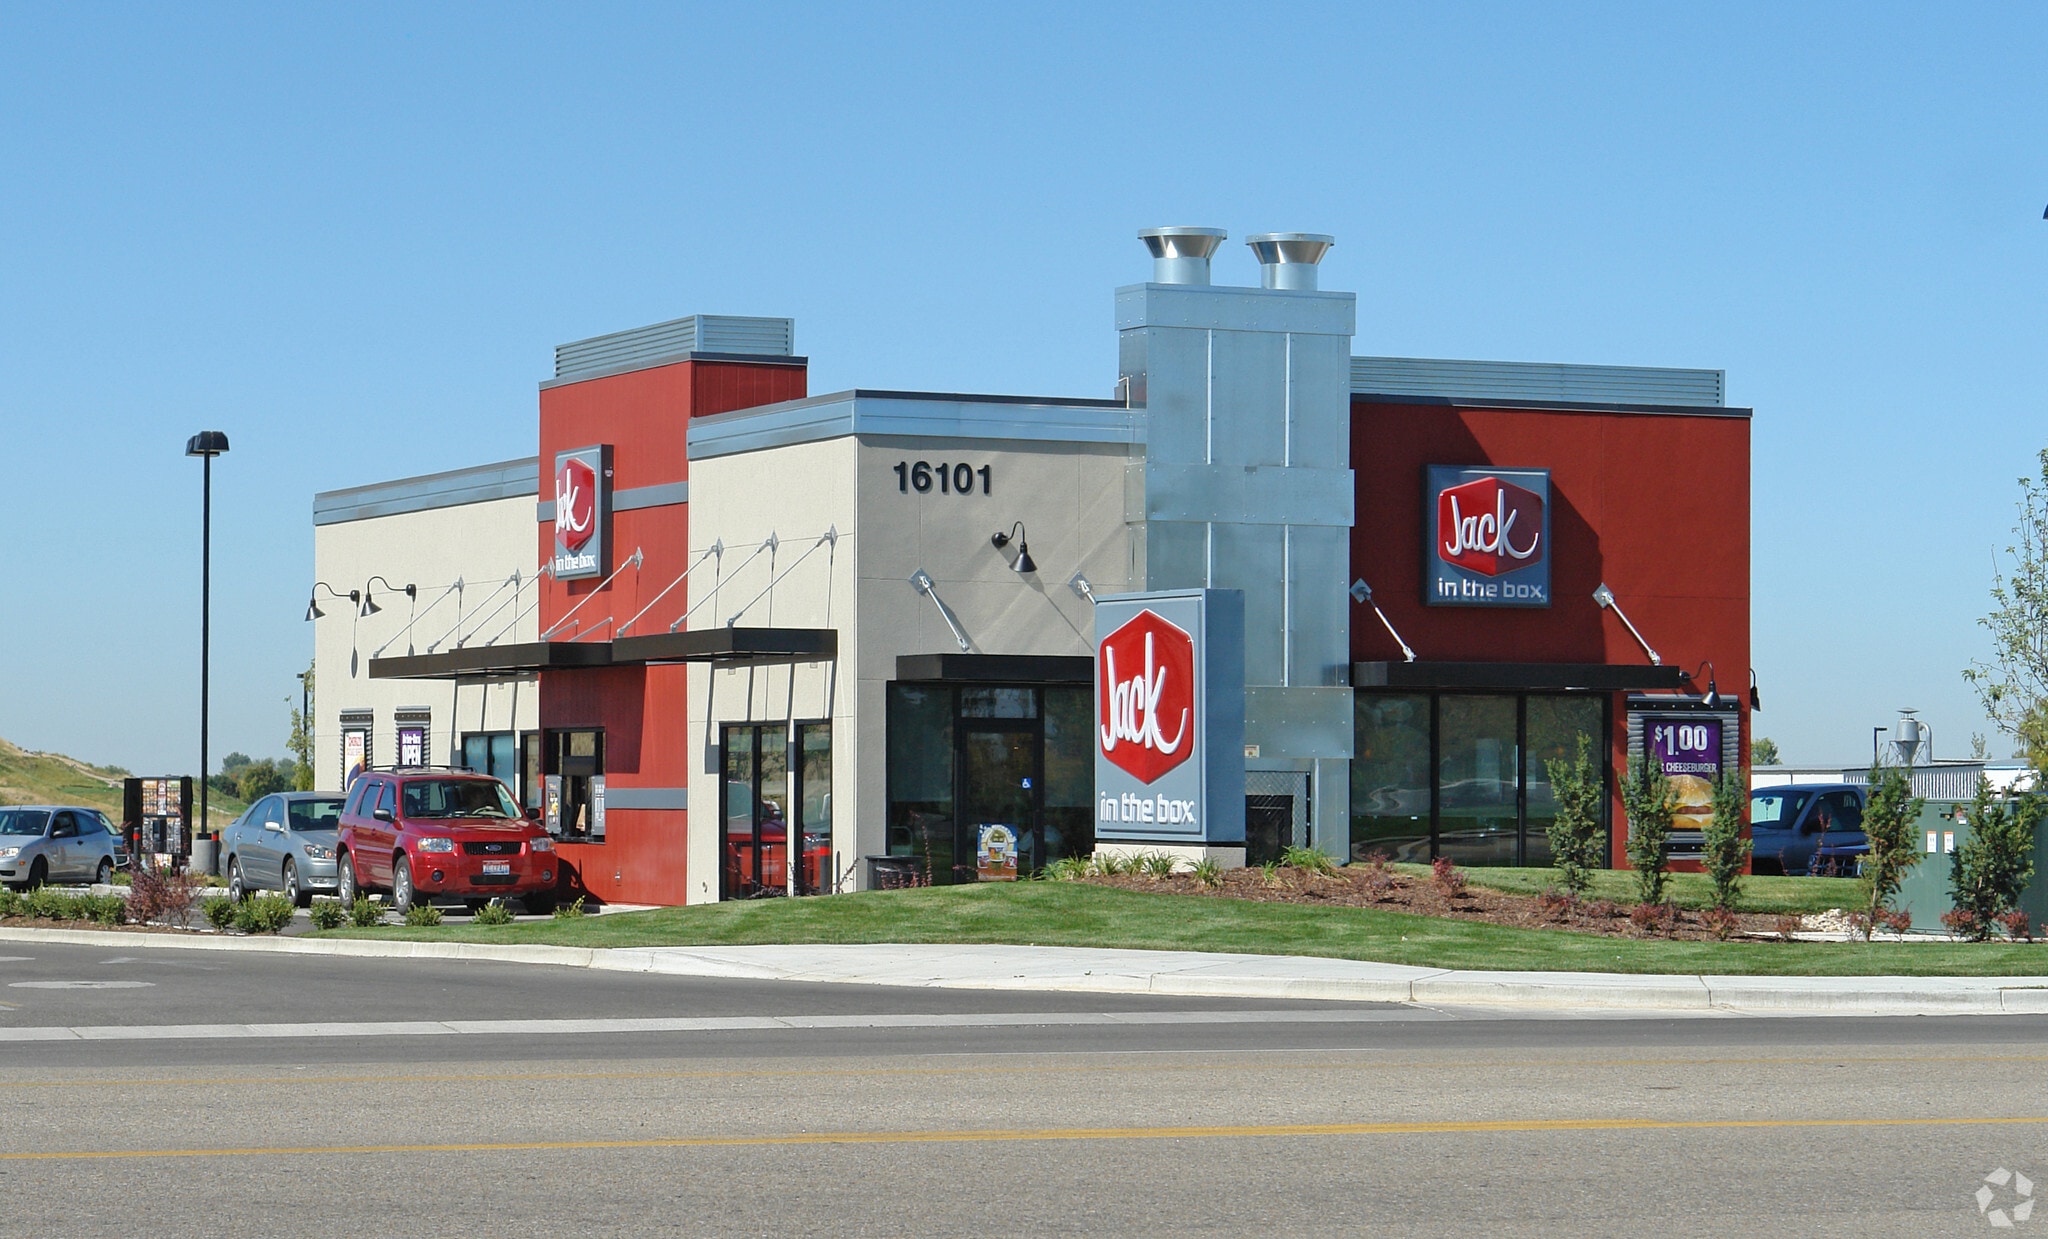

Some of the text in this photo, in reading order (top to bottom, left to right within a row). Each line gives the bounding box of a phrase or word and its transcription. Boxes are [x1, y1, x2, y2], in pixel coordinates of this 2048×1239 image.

[893, 461, 990, 494] 16101
[1445, 488, 1539, 560] Jack
[555, 555, 565, 572] in
[1438, 577, 1542, 598] in the box
[1101, 631, 1188, 755] Jack
[402, 744, 422, 766] OPEN
[1654, 725, 1708, 756] $1.00
[1665, 762, 1717, 773] CHEESEBURGER
[1100, 790, 1195, 824] in the box
